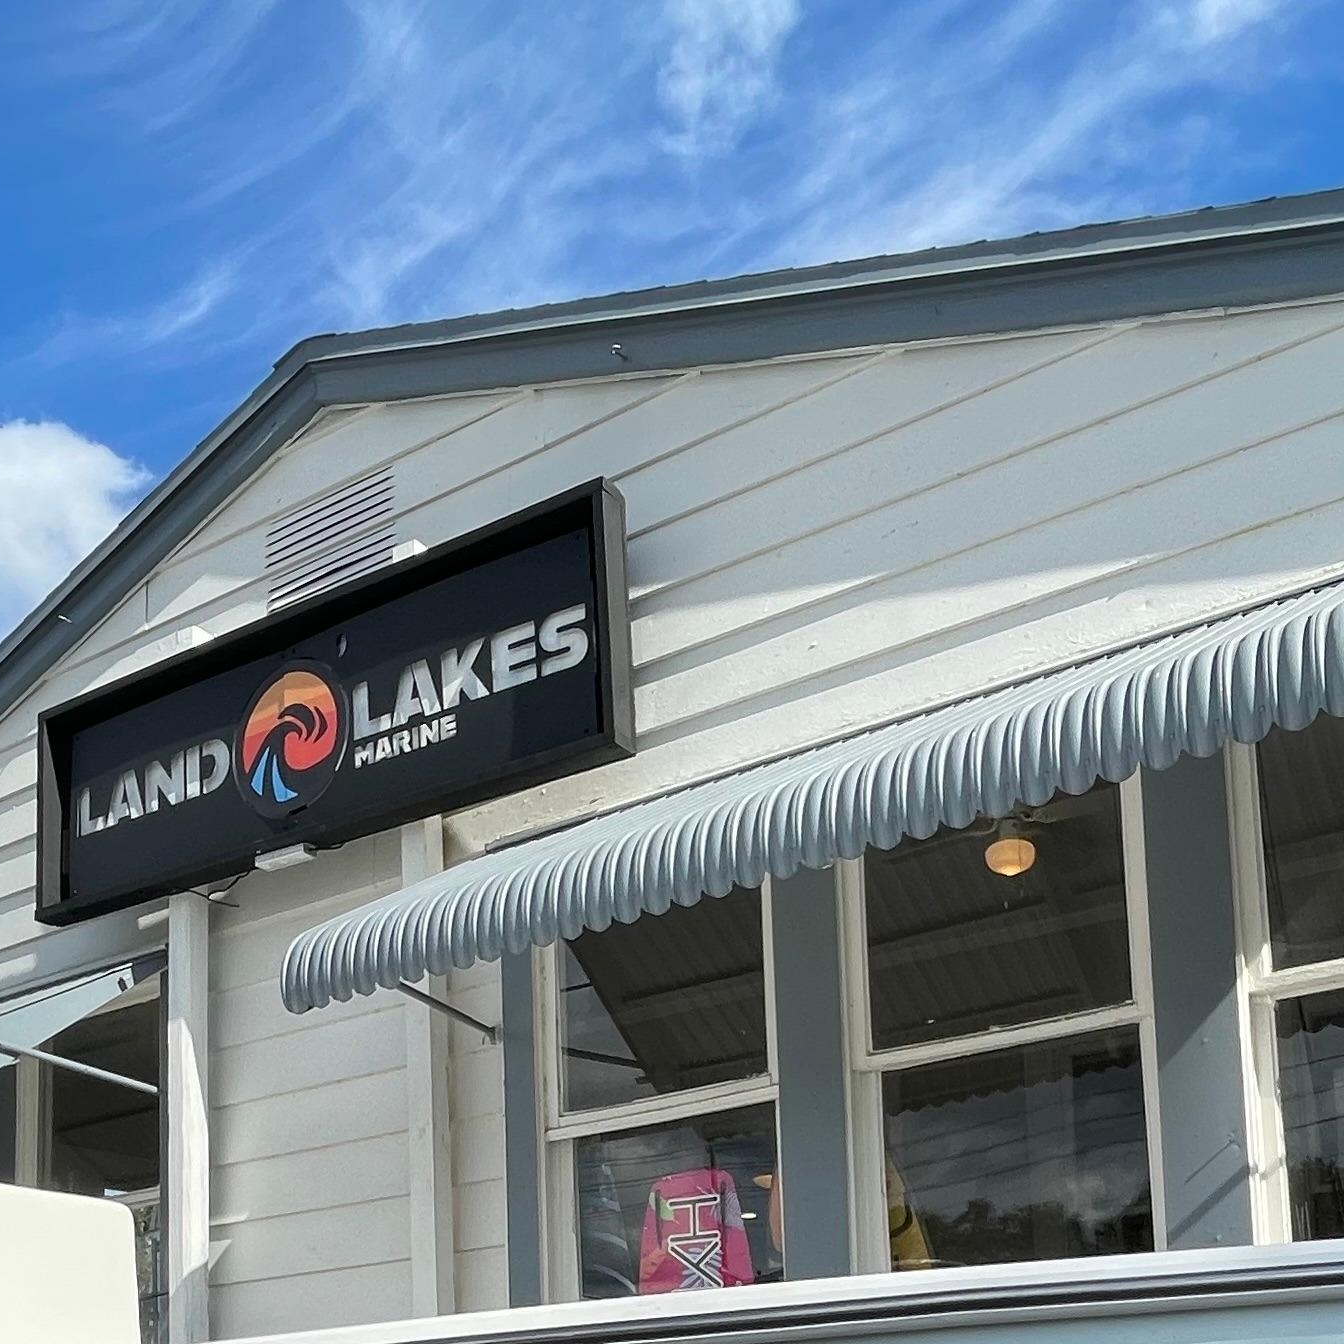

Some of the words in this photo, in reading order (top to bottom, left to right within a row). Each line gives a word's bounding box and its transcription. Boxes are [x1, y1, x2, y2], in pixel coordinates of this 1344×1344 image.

[77, 737, 231, 838] LAND
[352, 602, 591, 736] LAKES
[353, 713, 458, 769] MARINE
